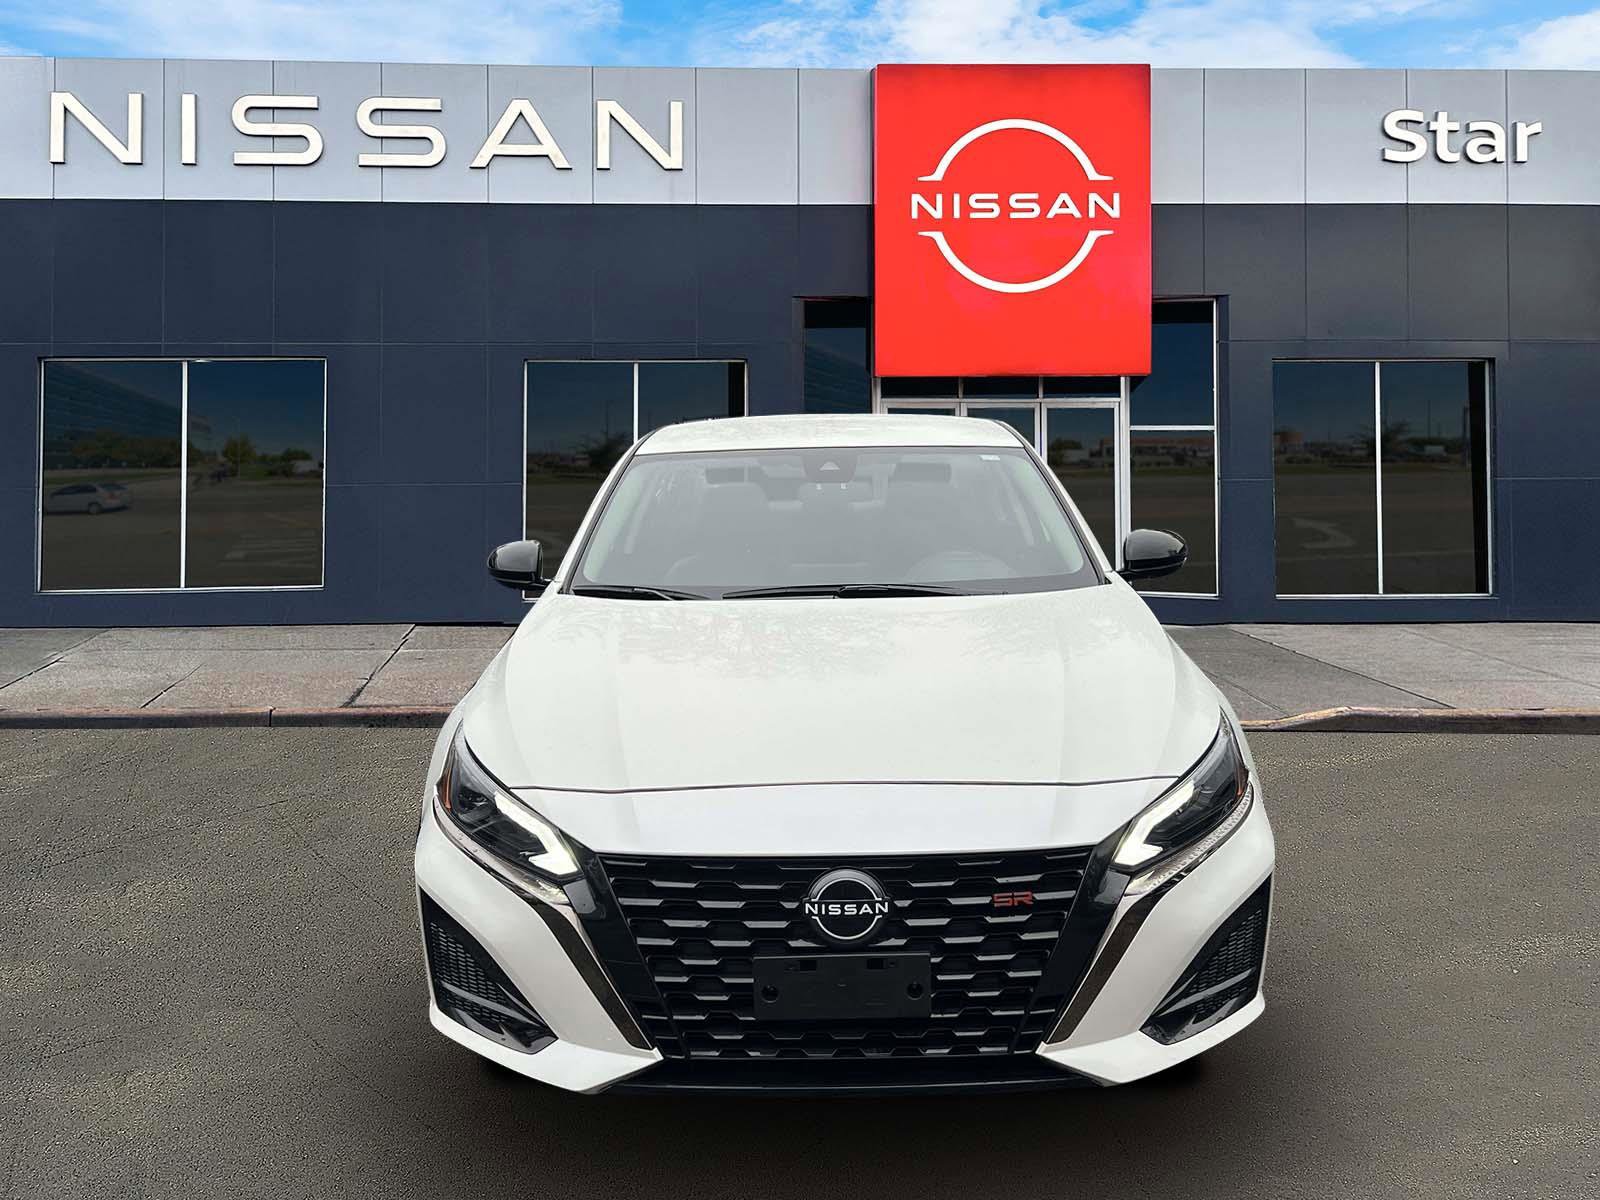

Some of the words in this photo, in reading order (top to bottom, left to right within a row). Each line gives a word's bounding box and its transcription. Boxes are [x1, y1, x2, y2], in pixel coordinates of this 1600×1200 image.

[49, 91, 684, 171] NISSAN
[1382, 109, 1543, 164] Star
[910, 192, 1121, 220] NISSAN
[804, 901, 889, 916] NISSAN
[992, 891, 1034, 907] SR
